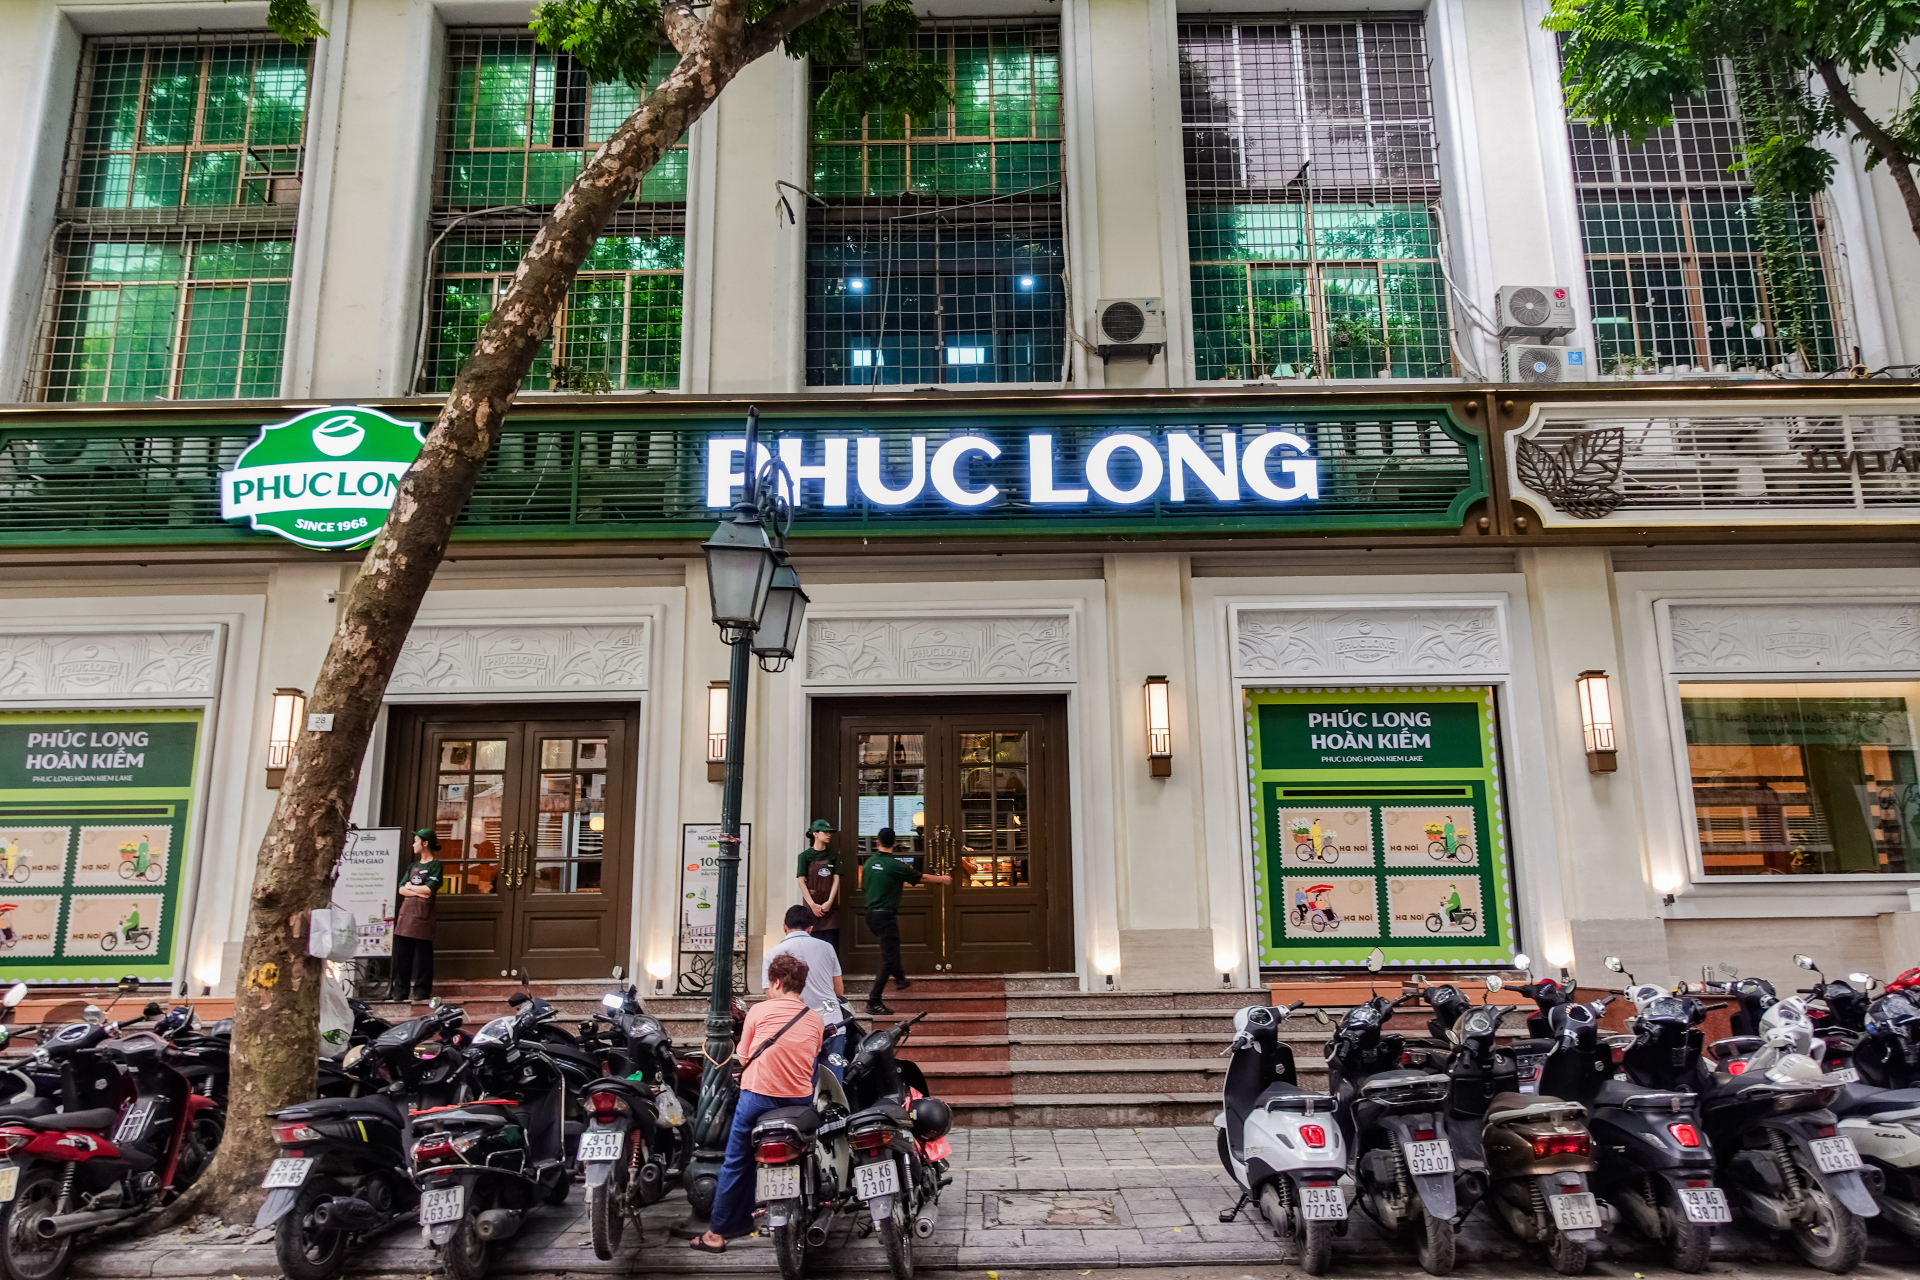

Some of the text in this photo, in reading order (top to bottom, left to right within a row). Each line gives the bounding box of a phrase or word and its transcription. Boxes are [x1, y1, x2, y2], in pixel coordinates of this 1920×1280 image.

[707, 431, 1319, 507] PHUC LONG
[233, 471, 401, 505] PHUC LON
[294, 517, 368, 532] SINCE 1968
[315, 716, 326, 724] 28
[1308, 709, 1432, 728] PHÚC LONG
[27, 729, 149, 748] PHÚC LONG
[1311, 727, 1431, 749] HOÀN KIẾM
[25, 747, 145, 769] HOÀN KIẾM
[587, 1134, 616, 1146] 29-C1
[1816, 1139, 1849, 1155] 26-B2
[1412, 1142, 1444, 1157] 29-P1
[275, 1159, 306, 1172] 29-E2
[1412, 1156, 1449, 1172] 929.07
[1821, 1153, 1859, 1170] 149.62
[764, 1168, 793, 1183] 12-F3
[861, 1163, 891, 1182] 29-K6
[763, 1182, 793, 1198] 0325
[864, 1178, 892, 1197] 2307
[427, 1190, 457, 1207] 29-K1
[1307, 1189, 1337, 1203] 29-AG
[1686, 1191, 1718, 1205] 29-AG
[424, 1203, 460, 1222] 463.37
[1306, 1203, 1344, 1218] 727.65
[1561, 1210, 1594, 1226] 6615
[1688, 1206, 1725, 1220] 438.77
